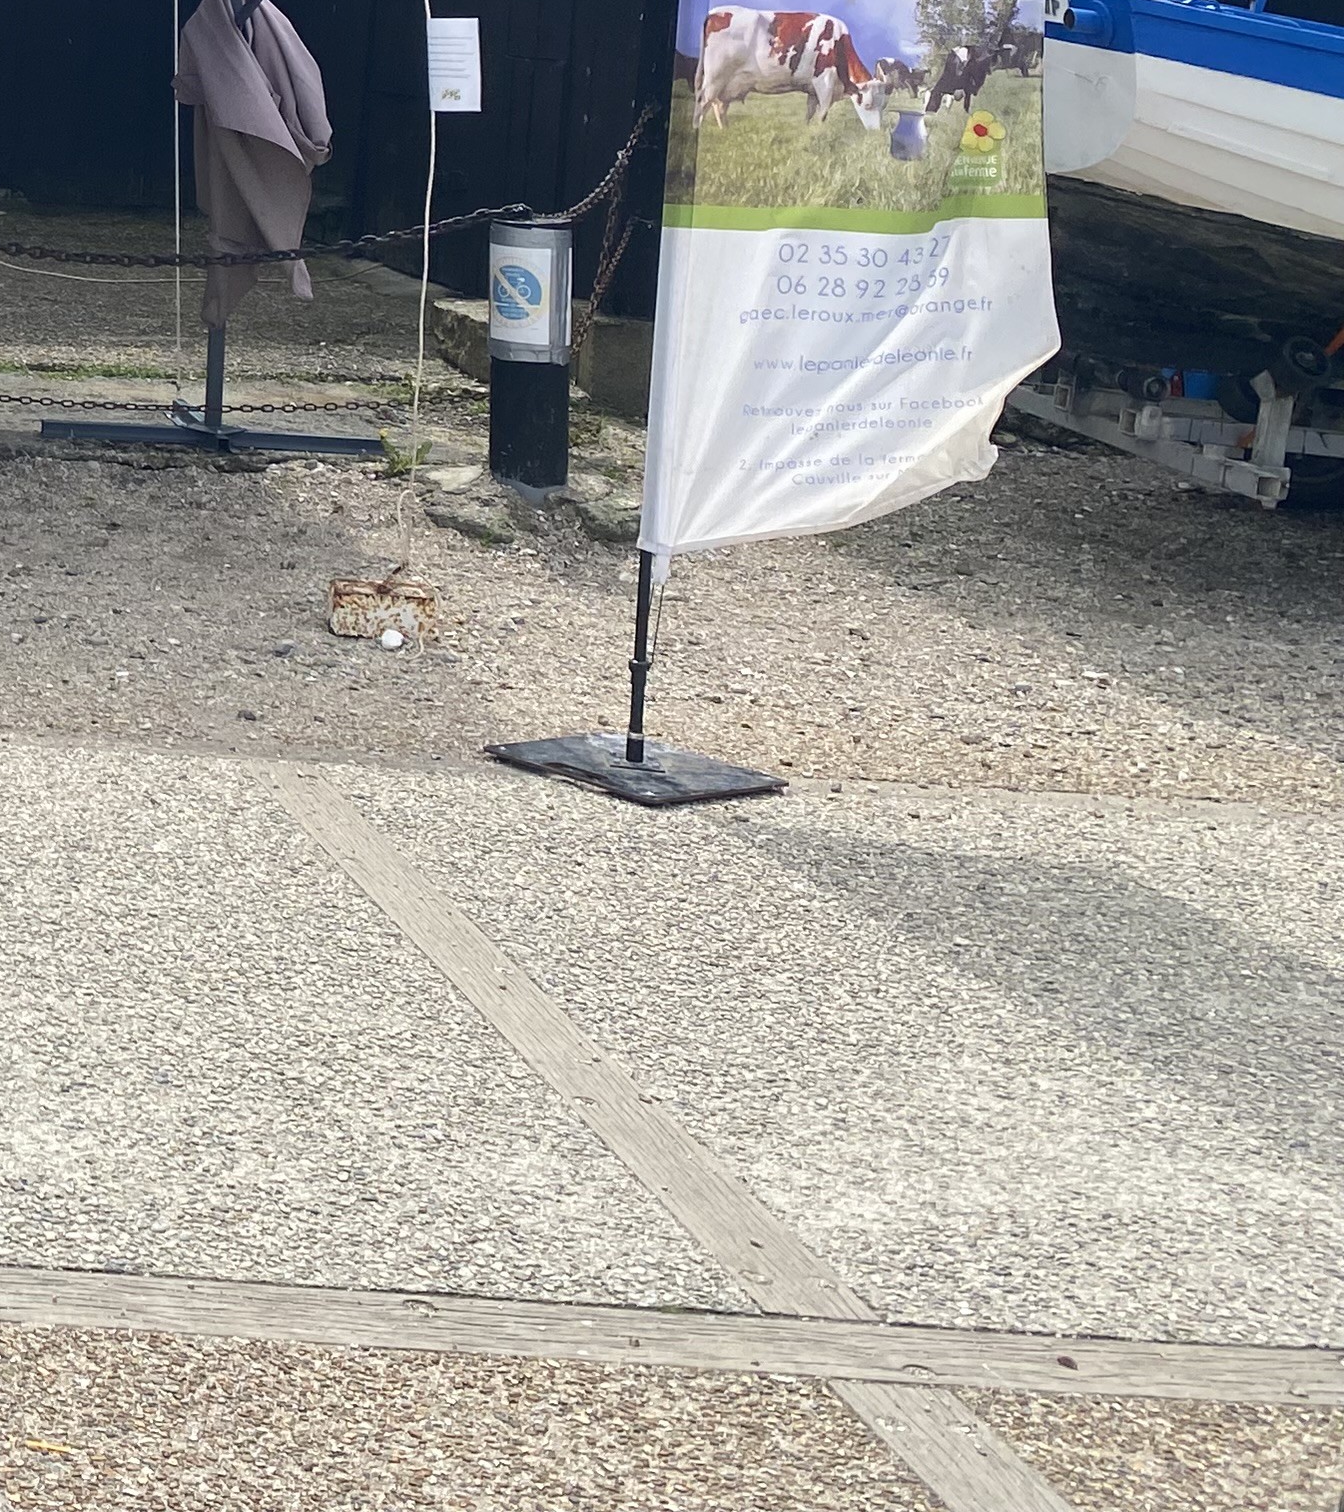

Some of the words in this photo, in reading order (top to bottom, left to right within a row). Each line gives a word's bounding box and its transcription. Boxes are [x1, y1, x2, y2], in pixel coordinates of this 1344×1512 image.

[779, 243, 809, 264] 02
[819, 245, 848, 266] 35
[857, 247, 888, 268] 30
[897, 247, 924, 266] 43
[777, 275, 807, 295] 06
[818, 276, 846, 297] 28
[856, 279, 885, 299] 92
[754, 346, 972, 374] www.lepaniedeleonie.fr
